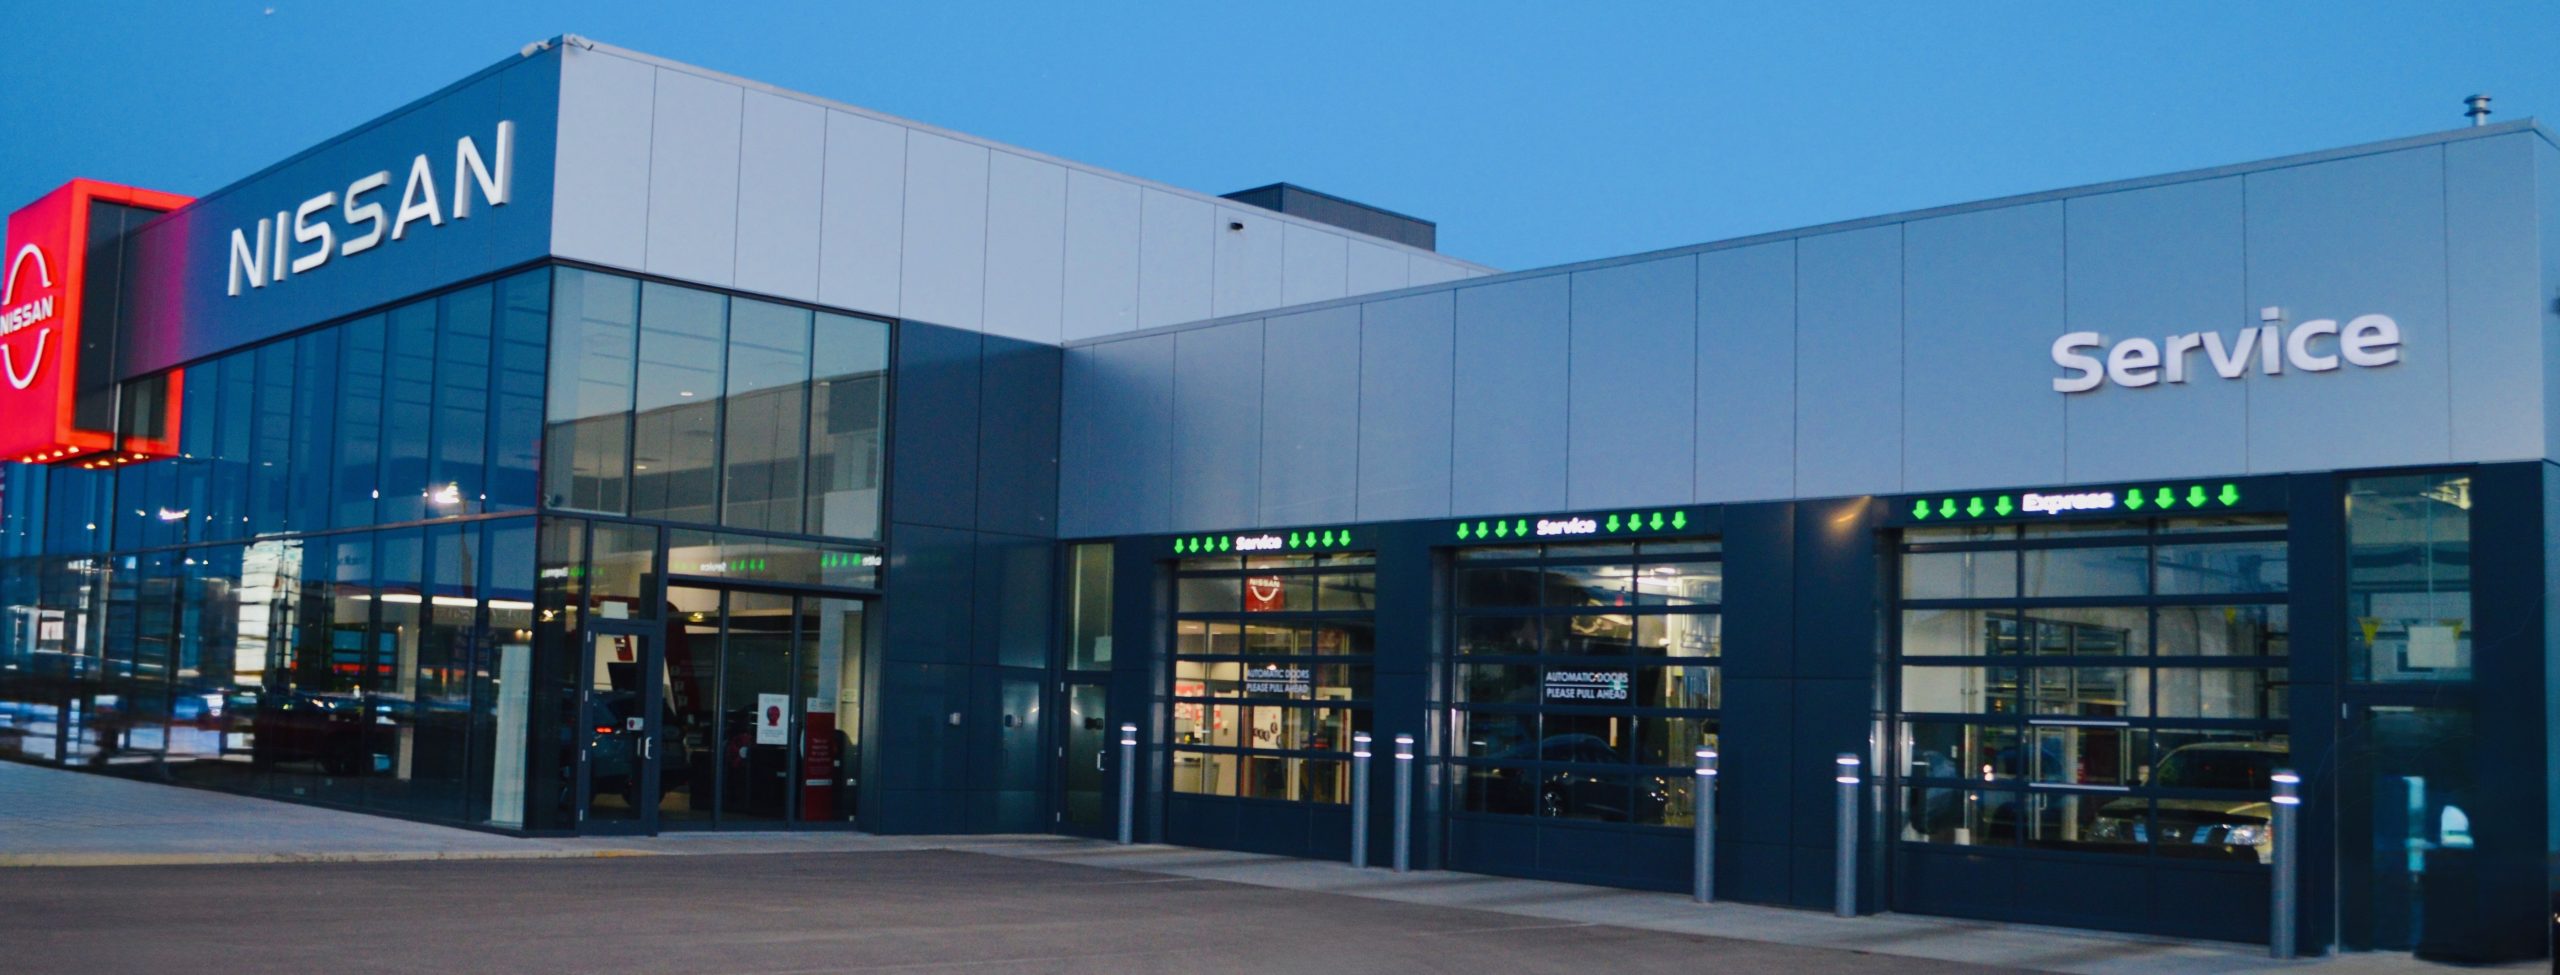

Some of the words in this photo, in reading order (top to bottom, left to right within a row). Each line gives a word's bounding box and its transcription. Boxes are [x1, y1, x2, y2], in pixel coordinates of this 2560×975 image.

[228, 120, 514, 297] NISSAN
[0, 295, 53, 337] NISSAN
[2051, 306, 2402, 393] Service
[2022, 492, 2115, 515] Express
[1536, 517, 1597, 535] Service
[1235, 534, 1282, 551] Service
[1247, 668, 1284, 678] AUTOMATIC
[1284, 669, 1310, 679] DOORS
[1545, 672, 1596, 682] AUTOMATIC
[1596, 672, 1628, 683] DOORS
[1246, 683, 1268, 692] PLEASE
[1269, 683, 1284, 692] PULL
[1285, 684, 1308, 693] AHEAD
[1546, 688, 1575, 698] PLEASE
[1576, 689, 1595, 699] PULL
[1596, 690, 1628, 700] AHEAD
